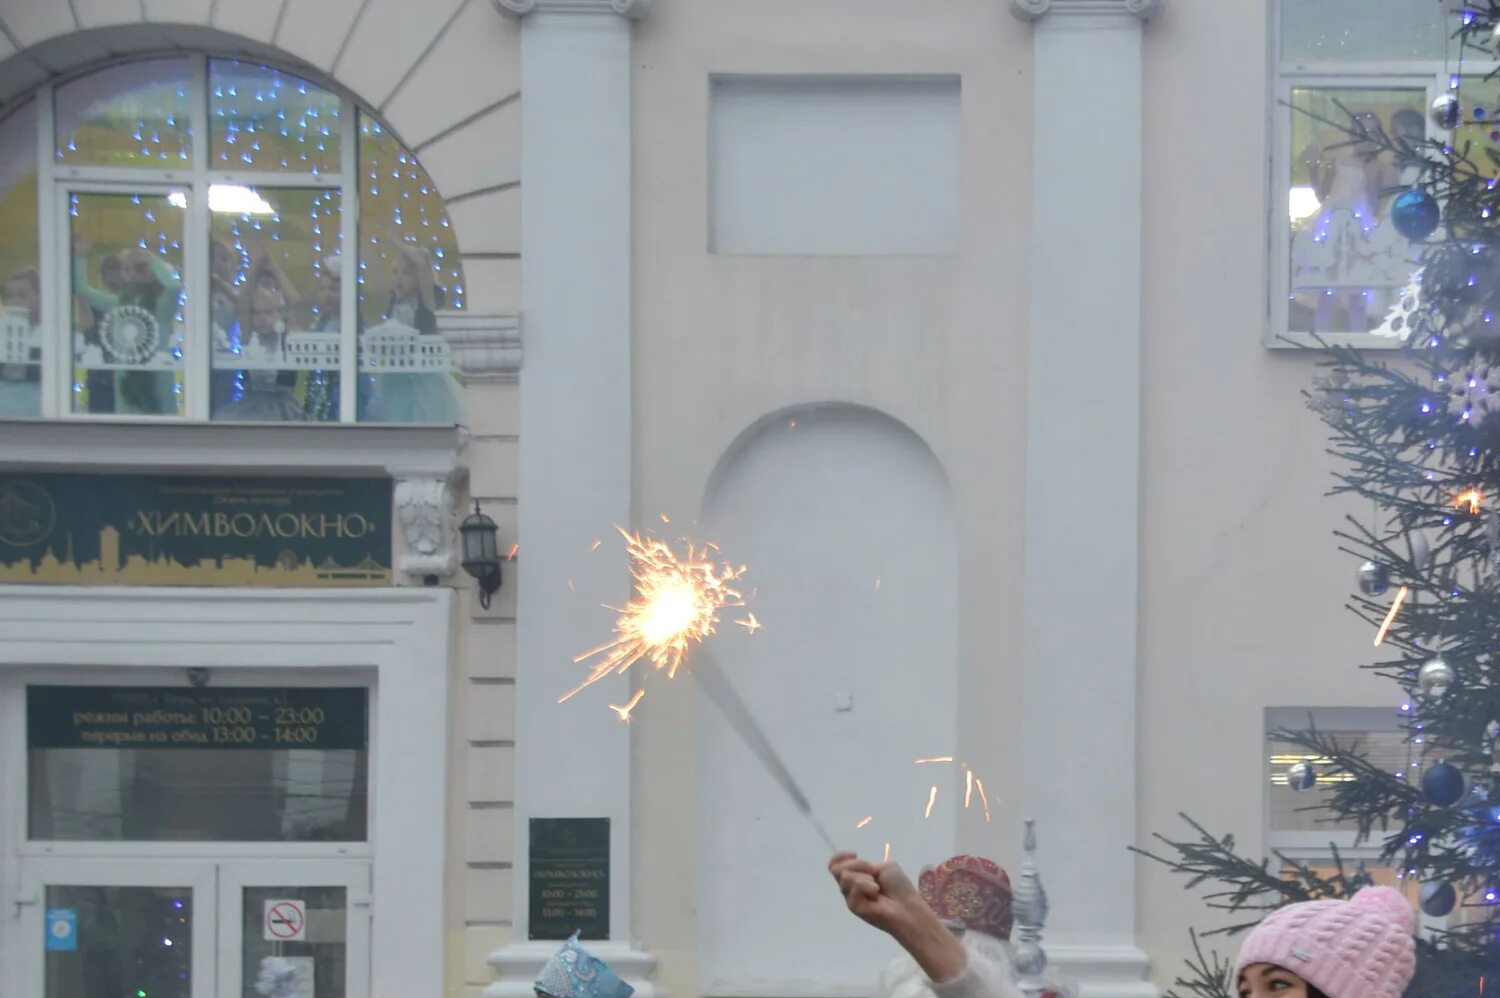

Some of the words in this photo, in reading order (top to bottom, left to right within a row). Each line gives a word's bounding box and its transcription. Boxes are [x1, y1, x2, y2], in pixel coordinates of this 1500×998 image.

[127, 510, 376, 538] «ХИМВОЛОКНО»
[202, 707, 252, 725] 10:00
[275, 707, 325, 725] 23:00
[213, 726, 256, 743] 13:00
[274, 726, 317, 743] 14:00
